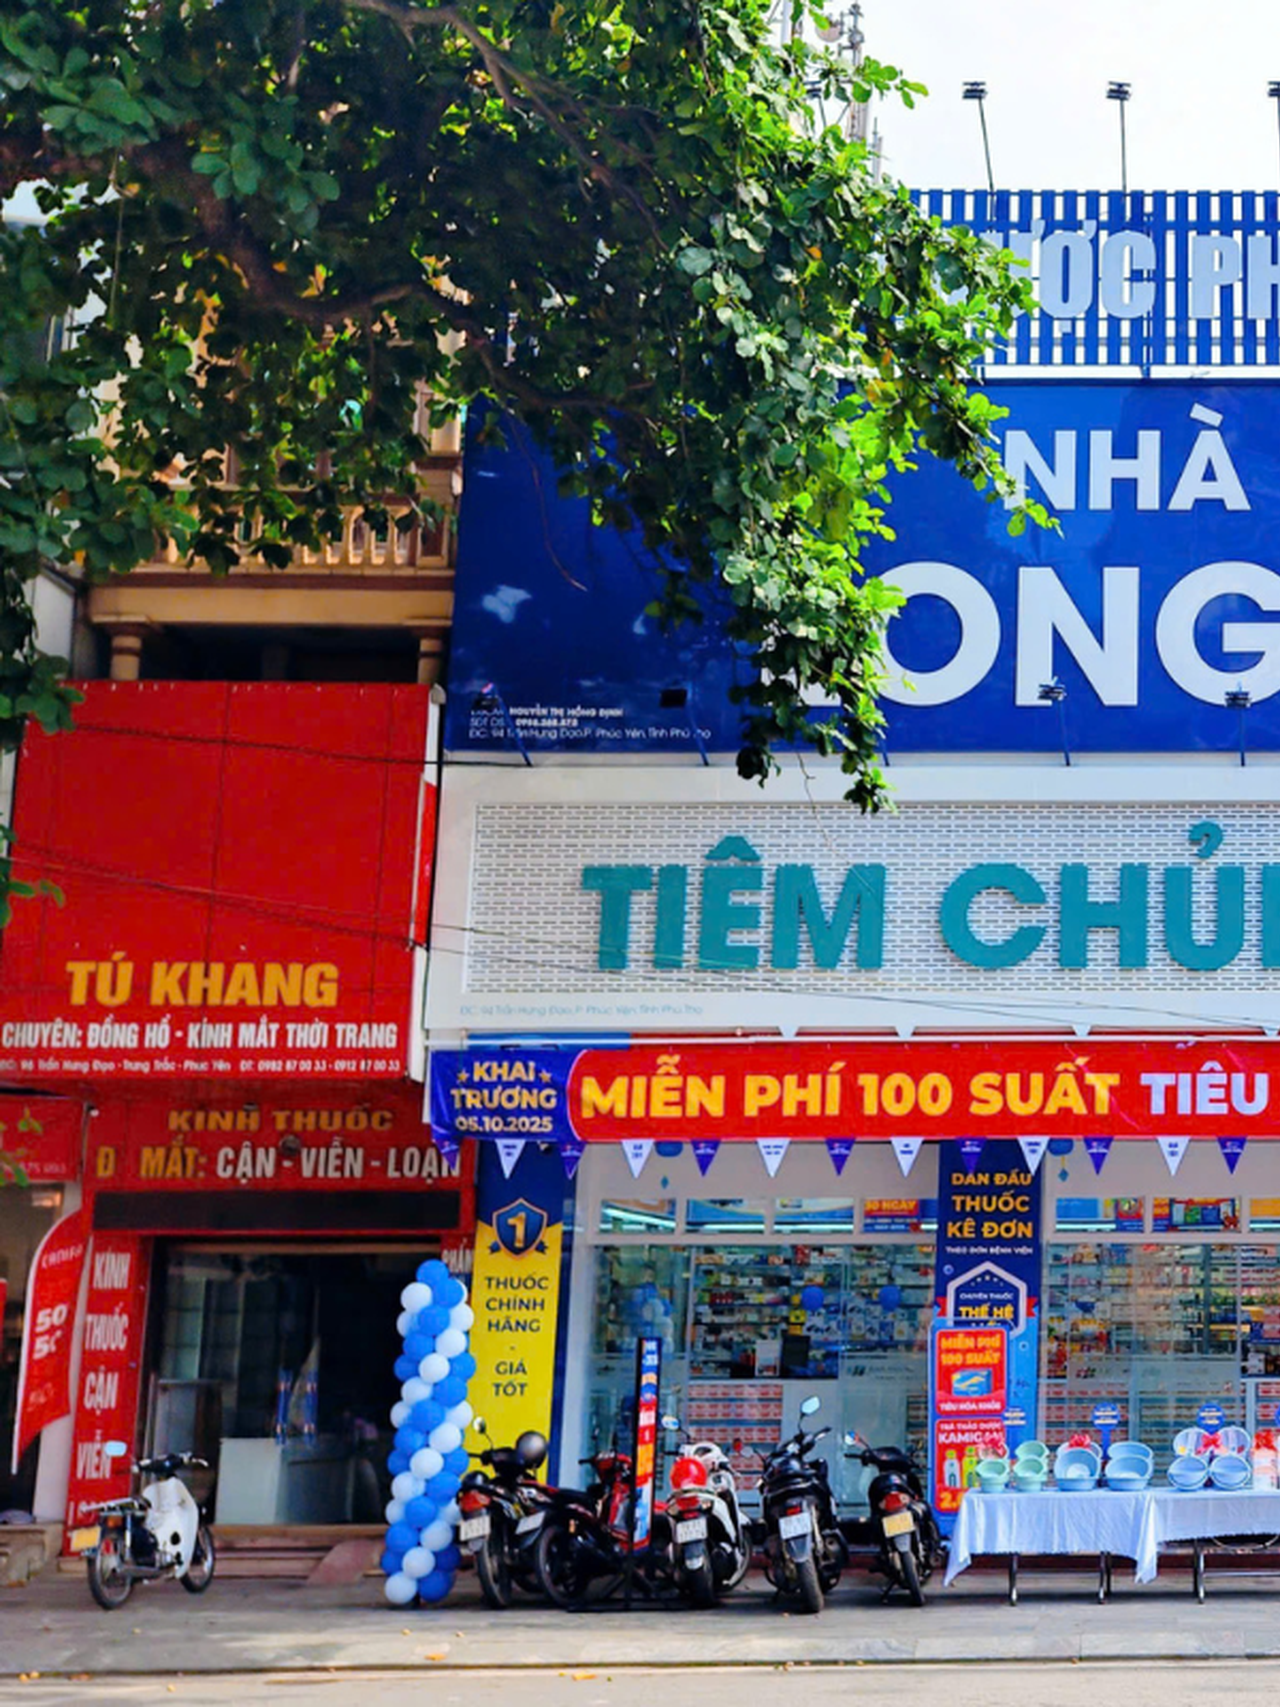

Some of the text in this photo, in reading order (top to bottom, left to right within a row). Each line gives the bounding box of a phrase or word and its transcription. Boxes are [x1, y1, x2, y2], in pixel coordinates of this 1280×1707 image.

[940, 219, 1156, 333] ƯỢC
[1003, 402, 1251, 511] NHÀ
[581, 836, 886, 971] TIÊM
[66, 951, 340, 1008] TÚ KHANG
[2, 1018, 83, 1049] CHUYÊN:
[335, 1022, 398, 1049] TRANG
[450, 1085, 557, 1109] TRƯƠNG
[580, 1054, 726, 1118] MIỄN
[744, 1062, 847, 1117] PHÍ
[858, 1073, 953, 1116] 100
[968, 1056, 1120, 1116] SUẤT
[1140, 1061, 1269, 1116] TIÊU
[455, 1116, 554, 1132] 05.10.2025
[141, 1137, 206, 1179] MẮT:
[216, 1141, 276, 1184] CẬN
[301, 1136, 364, 1179] VIỄN
[951, 1189, 1030, 1213] THUỐC
[507, 1212, 526, 1247] 1
[947, 1217, 1033, 1239] KÊ ĐƠN
[485, 1296, 545, 1312] CHÍNH
[495, 1357, 527, 1376] GIÁ
[492, 1378, 528, 1397] TỐT
